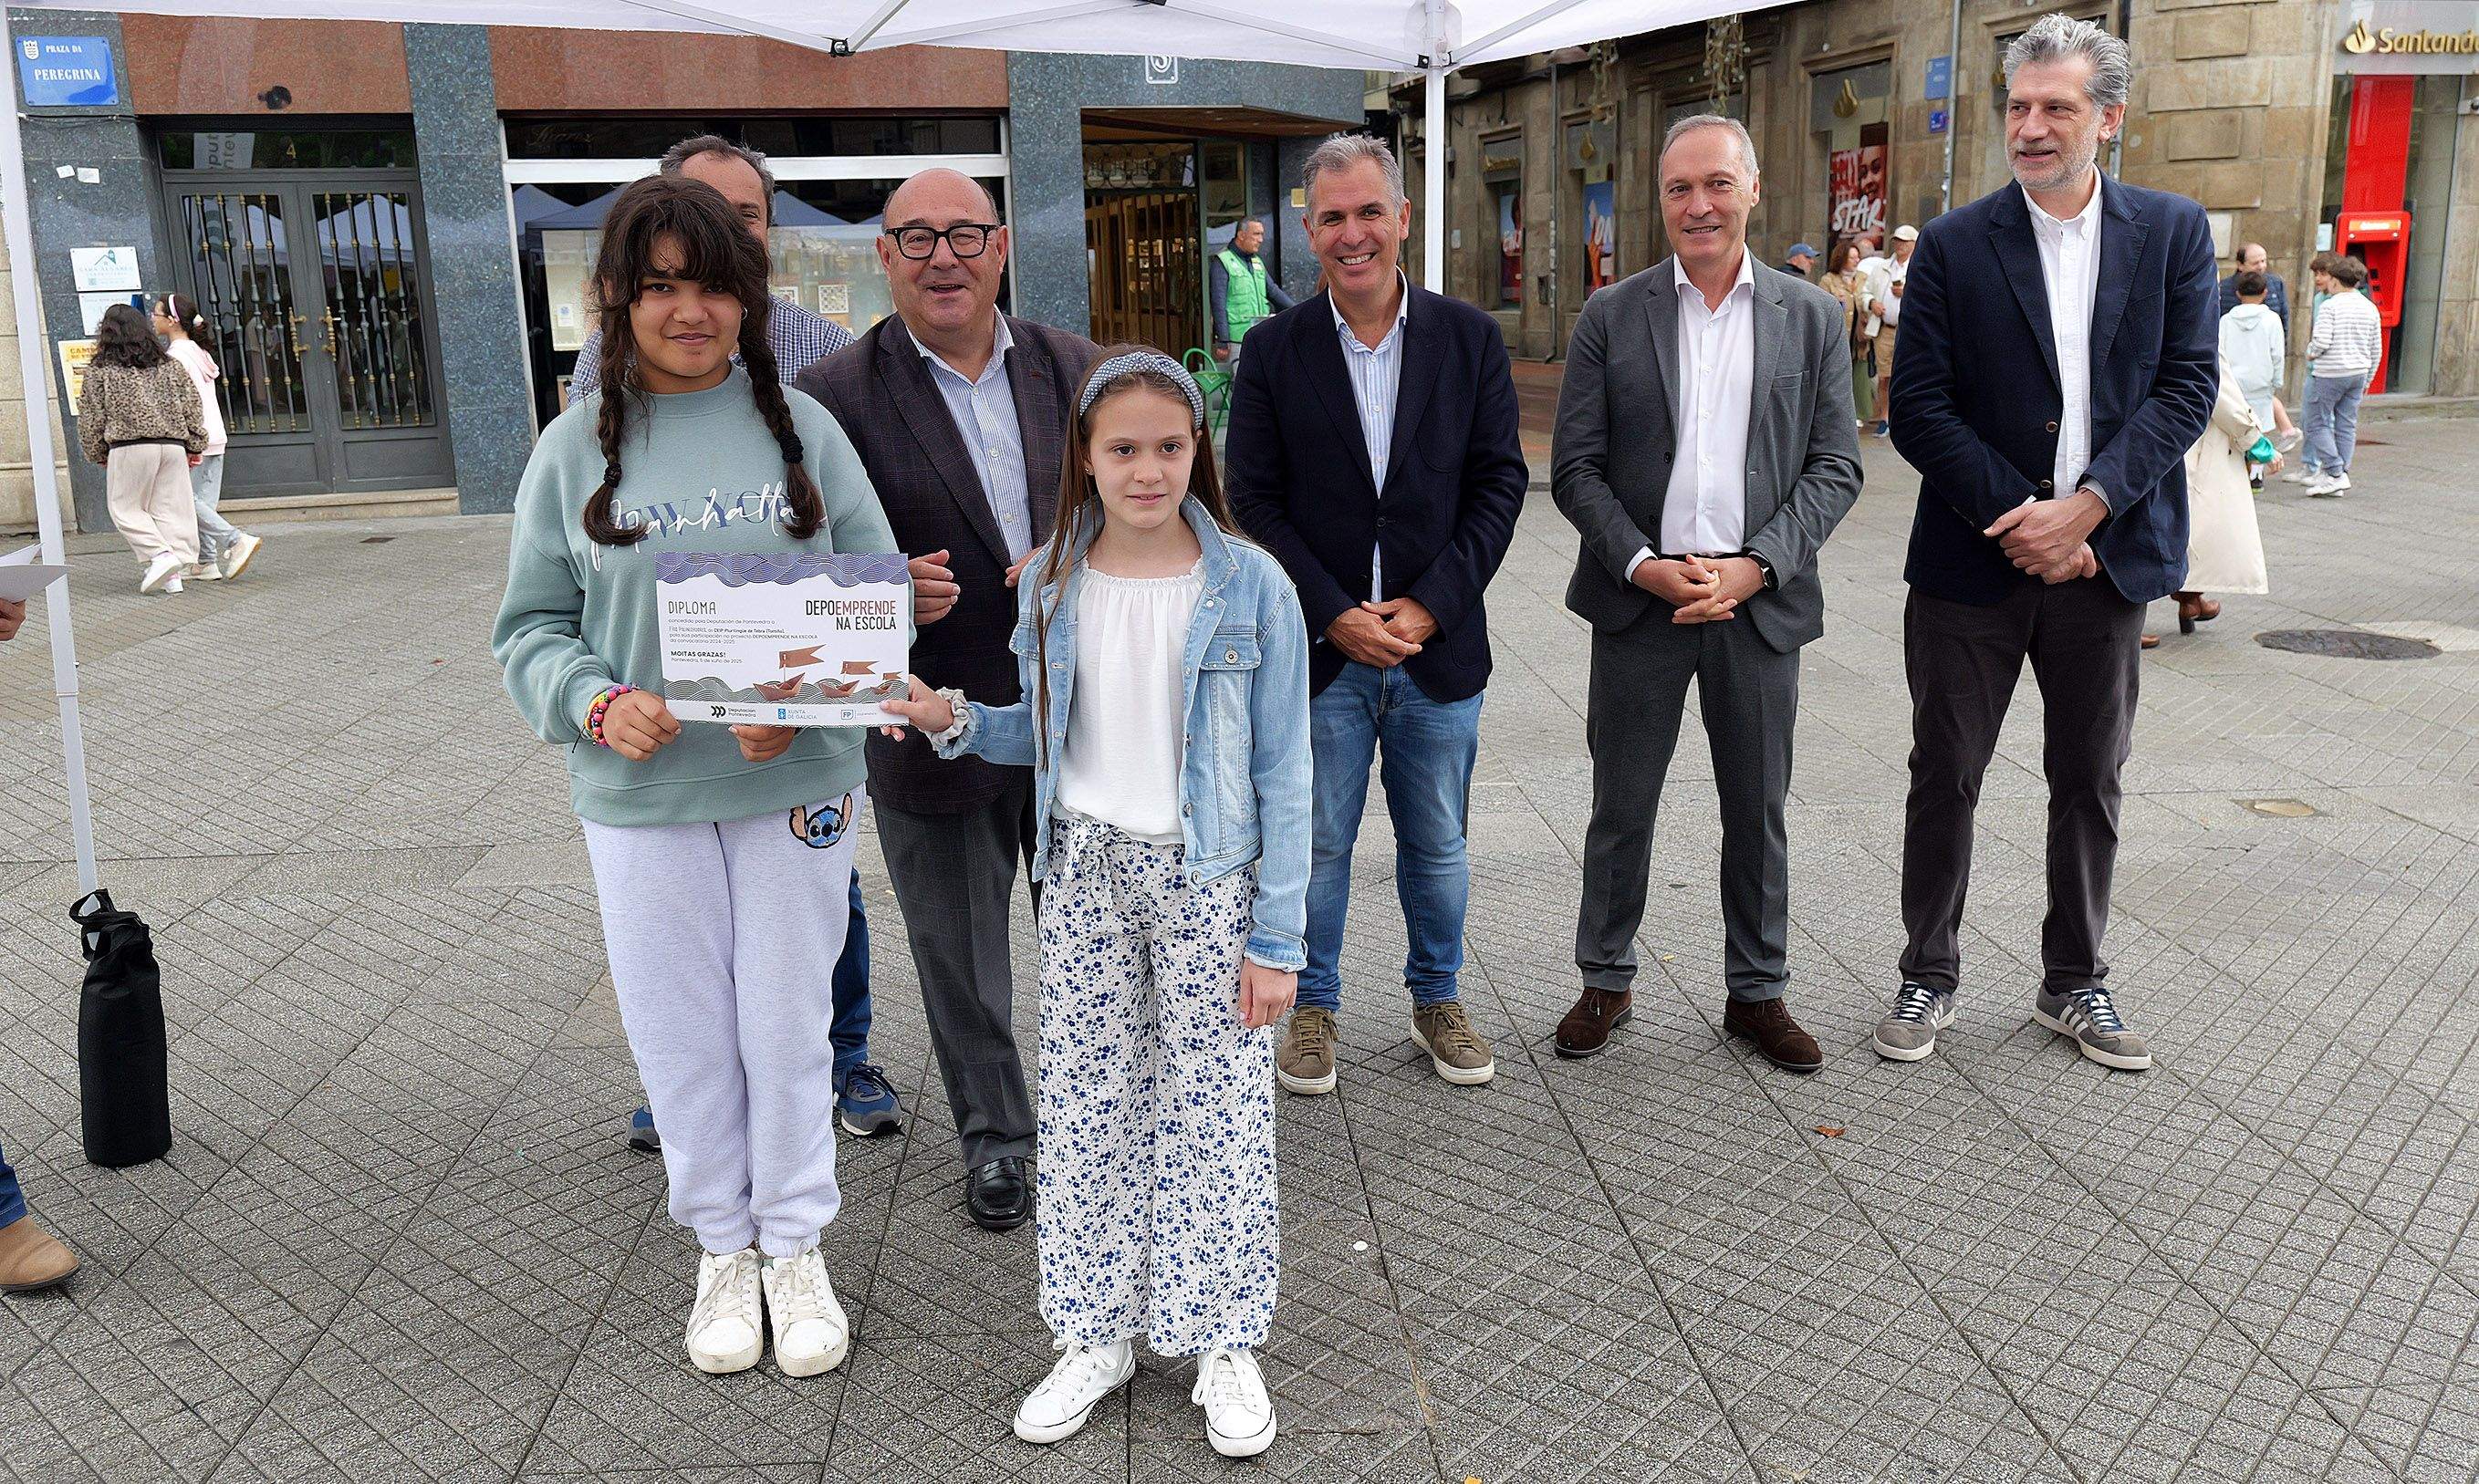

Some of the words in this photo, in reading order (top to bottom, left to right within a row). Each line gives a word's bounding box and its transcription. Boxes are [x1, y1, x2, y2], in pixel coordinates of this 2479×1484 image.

[46, 45, 70, 53] PRAZA
[72, 45, 82, 53] DA
[34, 68, 101, 81] PEREGRINA
[286, 139, 297, 160] 4
[668, 600, 717, 615] DIPLOMA
[806, 600, 897, 616] DEPOEMPRENDE
[836, 617, 851, 630] NA
[855, 617, 897, 630] ESCOLA
